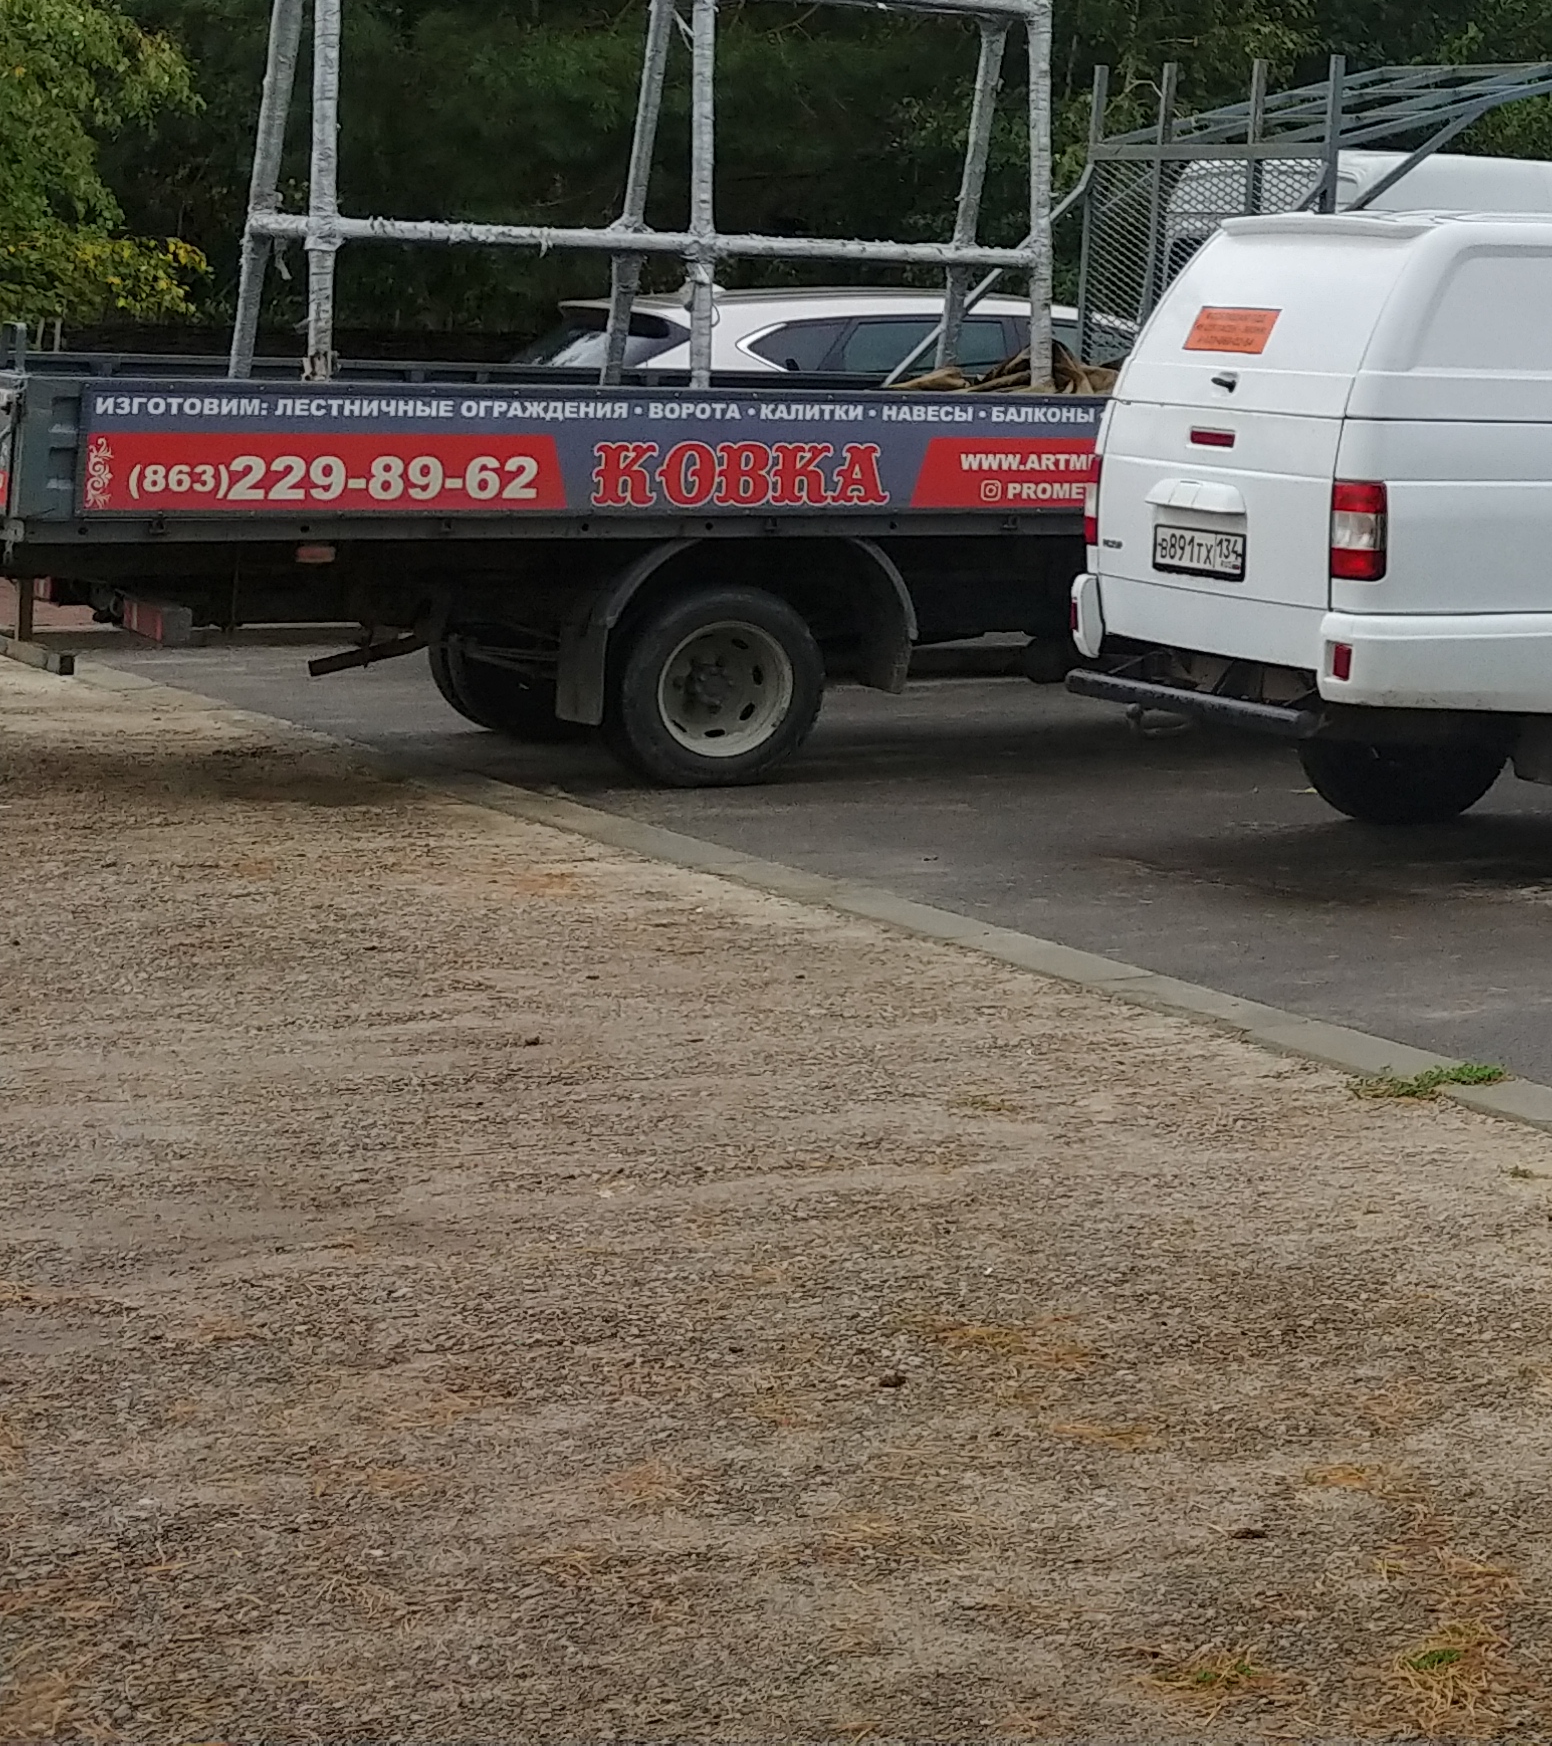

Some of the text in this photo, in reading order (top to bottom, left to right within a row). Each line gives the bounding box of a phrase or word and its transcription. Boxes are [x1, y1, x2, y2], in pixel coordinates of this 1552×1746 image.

[95, 397, 1095, 423] ИЗГОТОВИМ: ЛЕСТНИЧНЫЕ ОГРАЖДЕНИЯ ВОРОТА КАЛИТКИ НАВЕСЫ БАЛКОНЫ
[127, 455, 538, 501] (863)229-89-62
[591, 441, 889, 508] КОВКА
[1007, 482, 1086, 500] PROME
